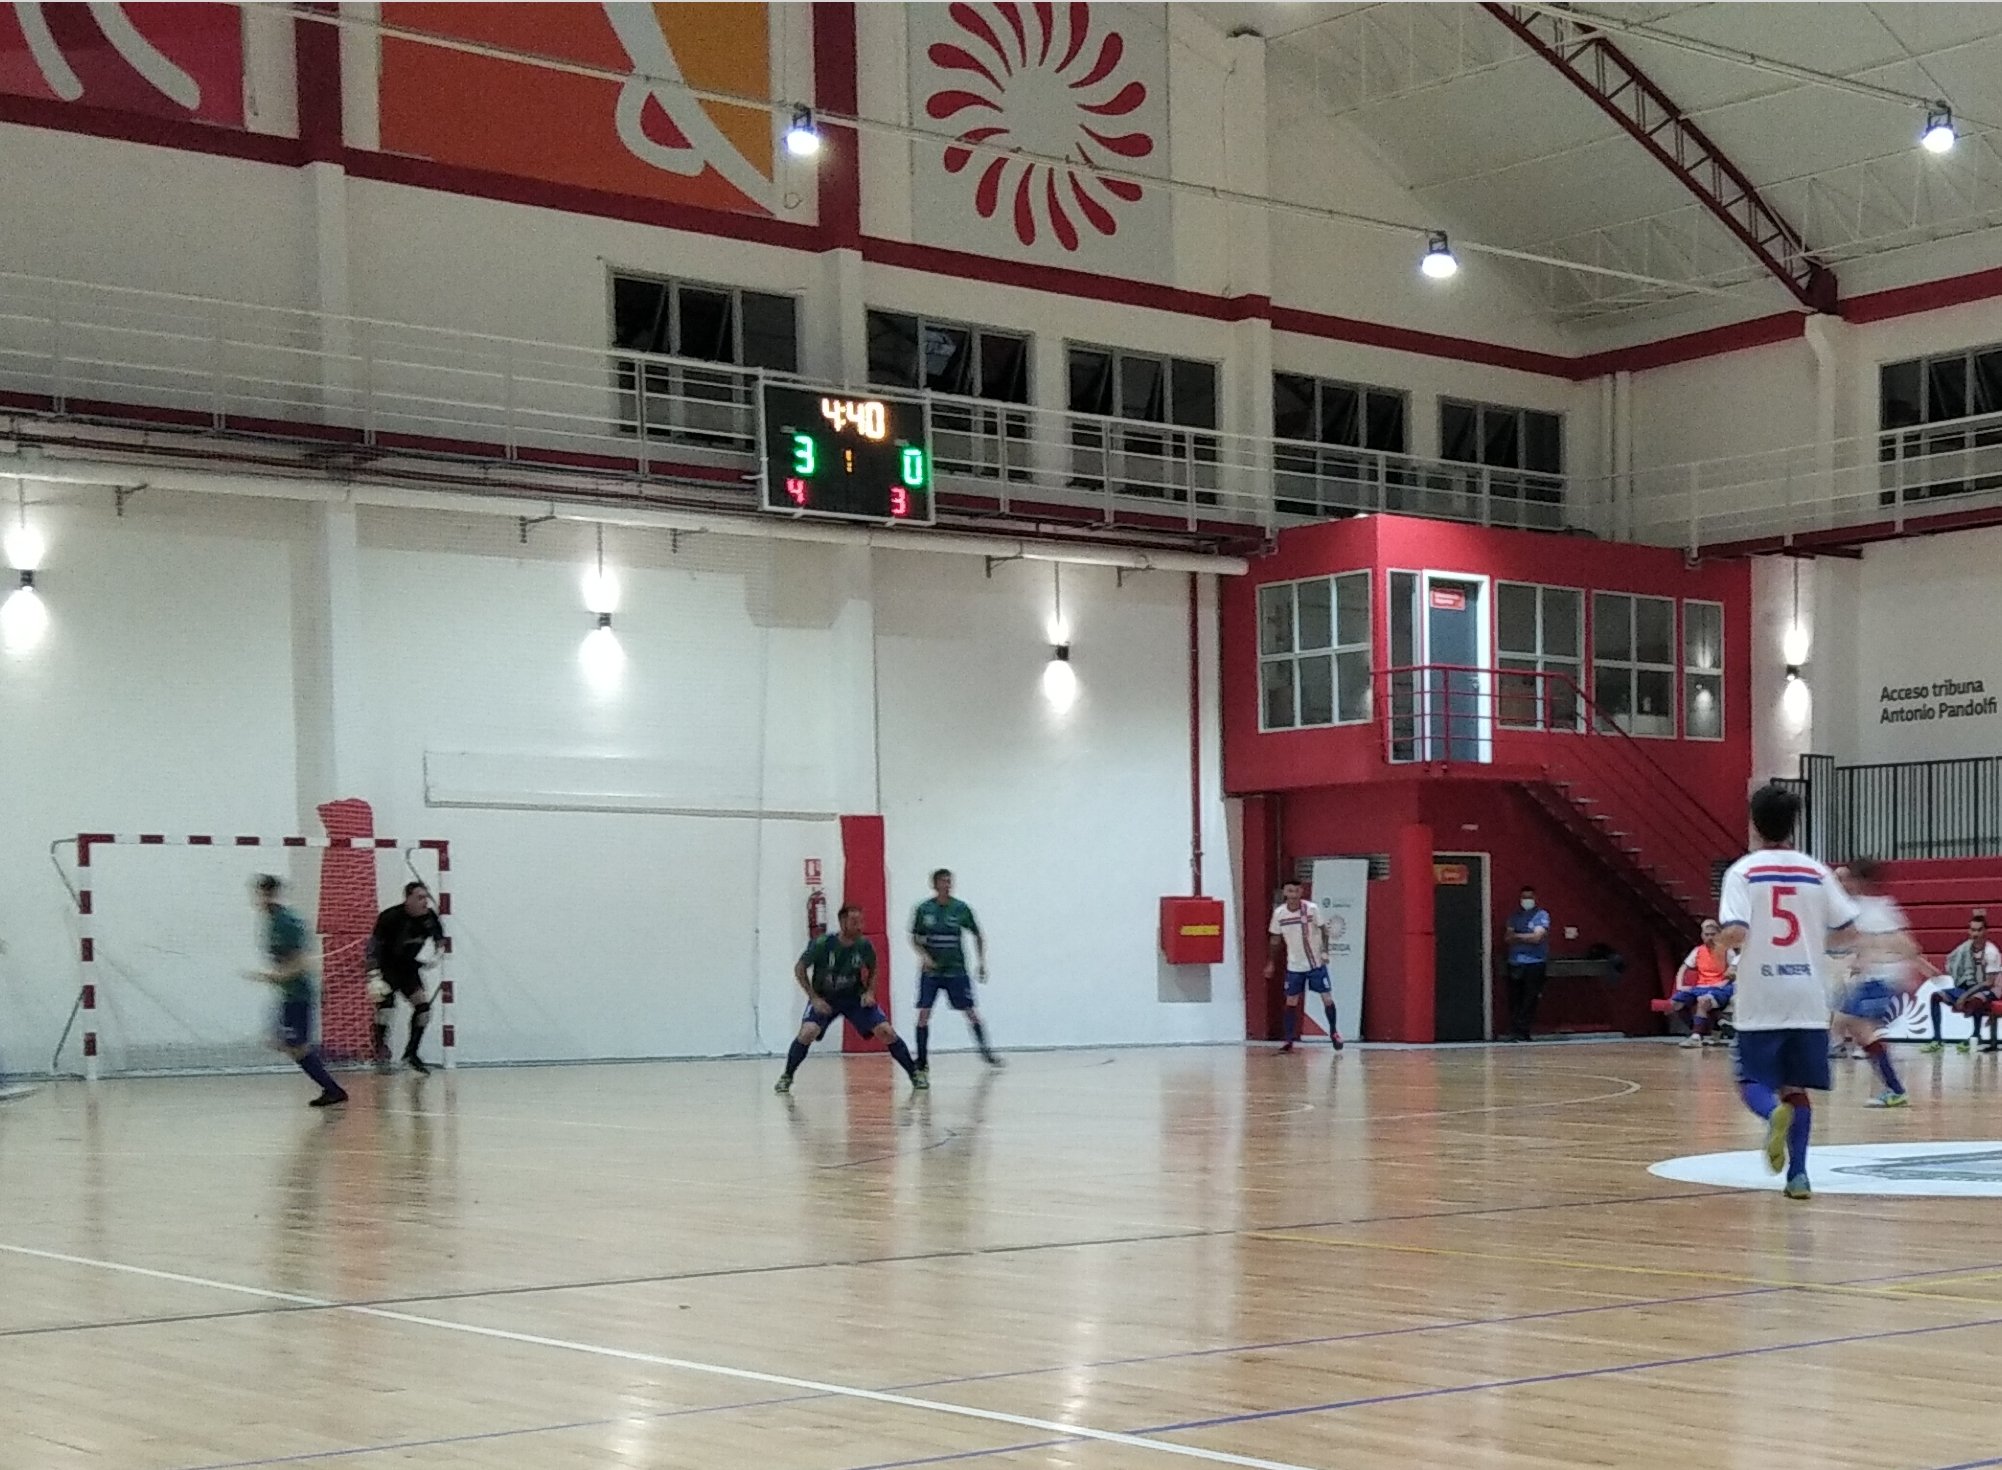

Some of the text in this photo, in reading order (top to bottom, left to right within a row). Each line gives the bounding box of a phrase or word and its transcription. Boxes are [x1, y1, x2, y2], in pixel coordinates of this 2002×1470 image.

[821, 398, 886, 439] 4:40
[794, 435, 815, 474] 3
[903, 448, 923, 485] 0
[786, 478, 906, 514] 4 3
[1880, 679, 1985, 702] Acceso tribuna
[1880, 696, 1998, 724] Antonio Pandolfi
[1771, 885, 1799, 947] 5
